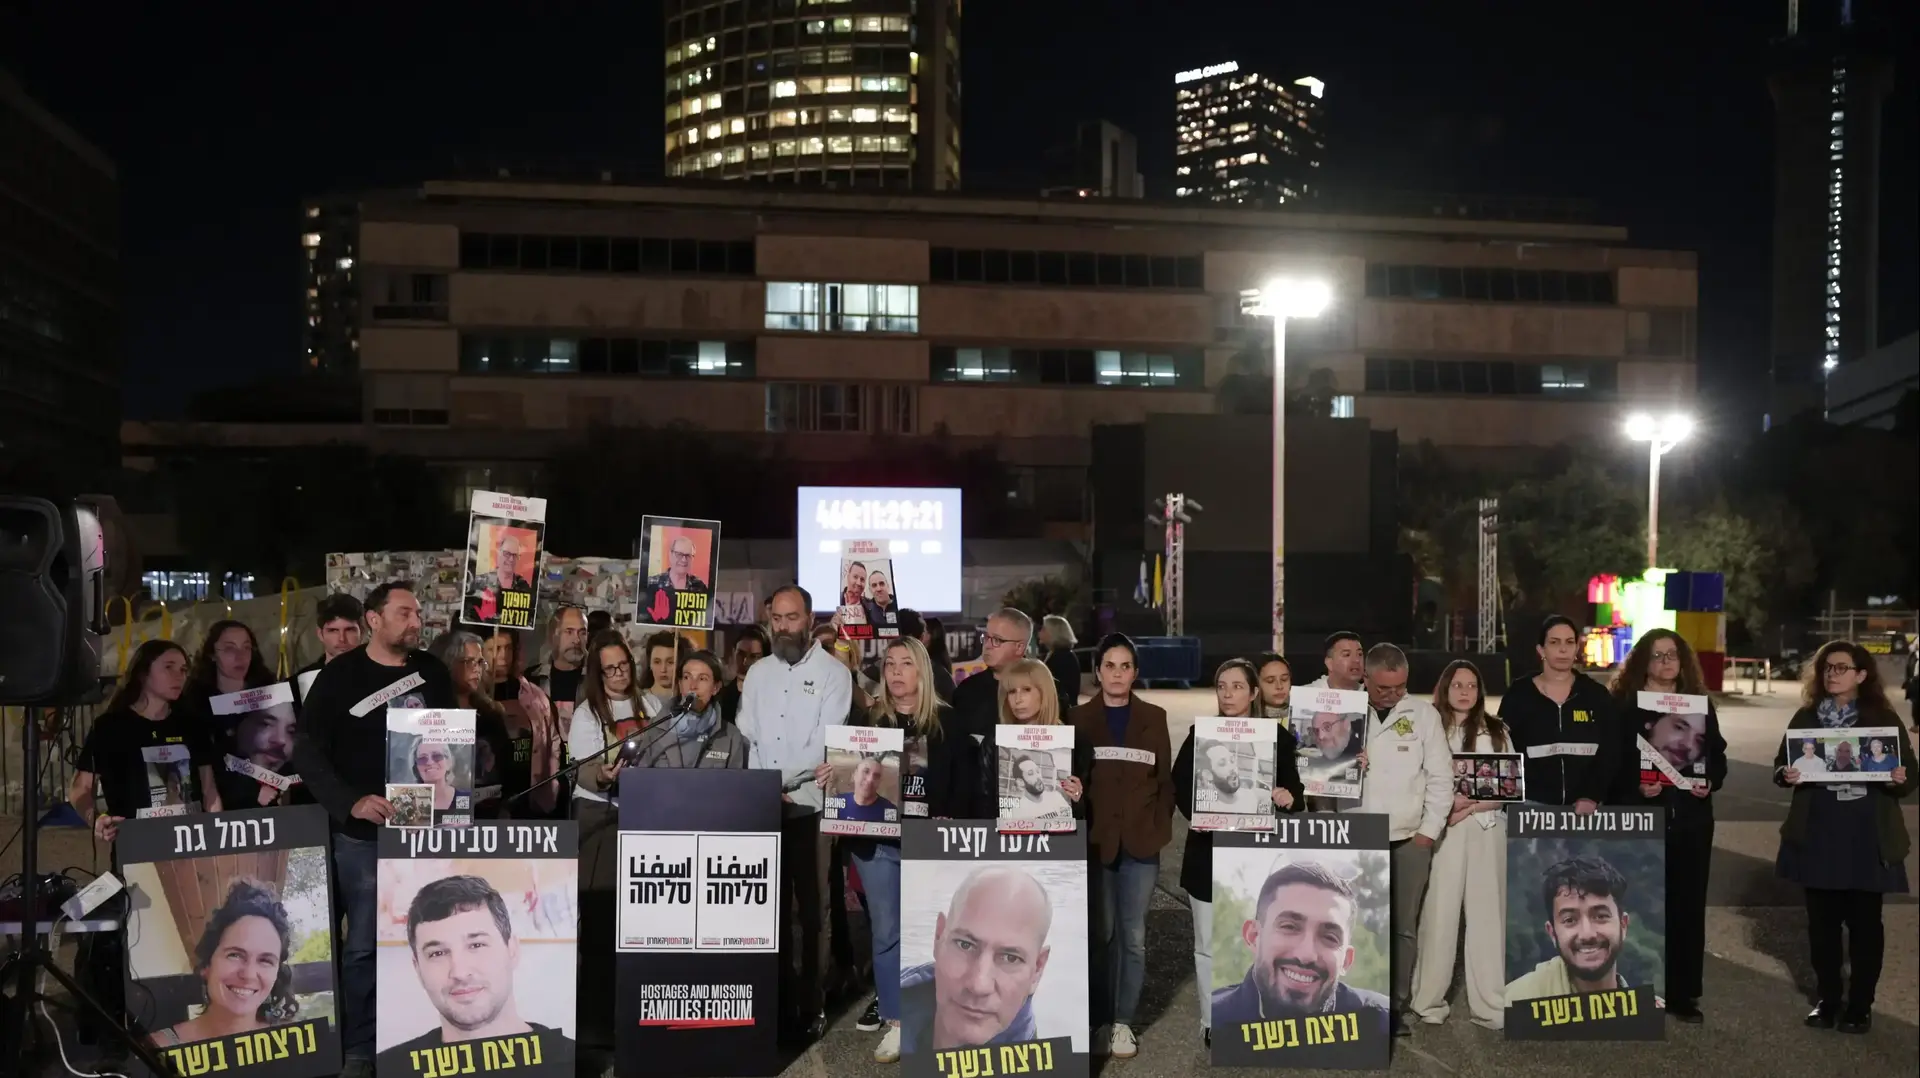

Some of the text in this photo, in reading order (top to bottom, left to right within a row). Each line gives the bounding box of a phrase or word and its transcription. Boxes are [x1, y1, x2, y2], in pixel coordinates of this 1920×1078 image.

[502, 591, 530, 609] הופקר
[675, 591, 707, 610] הופקר
[501, 608, 528, 626] ונרצח
[674, 609, 706, 627] ונרצח
[825, 797, 846, 808] BRING
[999, 797, 1020, 808] BRING
[1196, 790, 1218, 800] BRING
[824, 808, 838, 819] HIM
[999, 808, 1013, 818] HIM
[1519, 809, 1555, 833] פולין
[1621, 812, 1654, 831] הרש
[174, 817, 275, 853] כרמל גת
[507, 826, 558, 852] איתי
[937, 827, 988, 857] קציר
[1308, 819, 1350, 844] אורי
[630, 879, 692, 904] סליחה
[706, 880, 768, 905] סליחה
[640, 984, 753, 999] HOSTAGES AND MISSING
[640, 999, 752, 1020] FAMILIES FORUM
[1531, 990, 1638, 1026] נרצח בשבי
[1241, 1013, 1359, 1050] נרצח בשבי
[234, 1023, 317, 1067] נרצחה
[410, 1035, 543, 1078] נרצח בשבי
[936, 1042, 1053, 1078] נרצח בשבי
